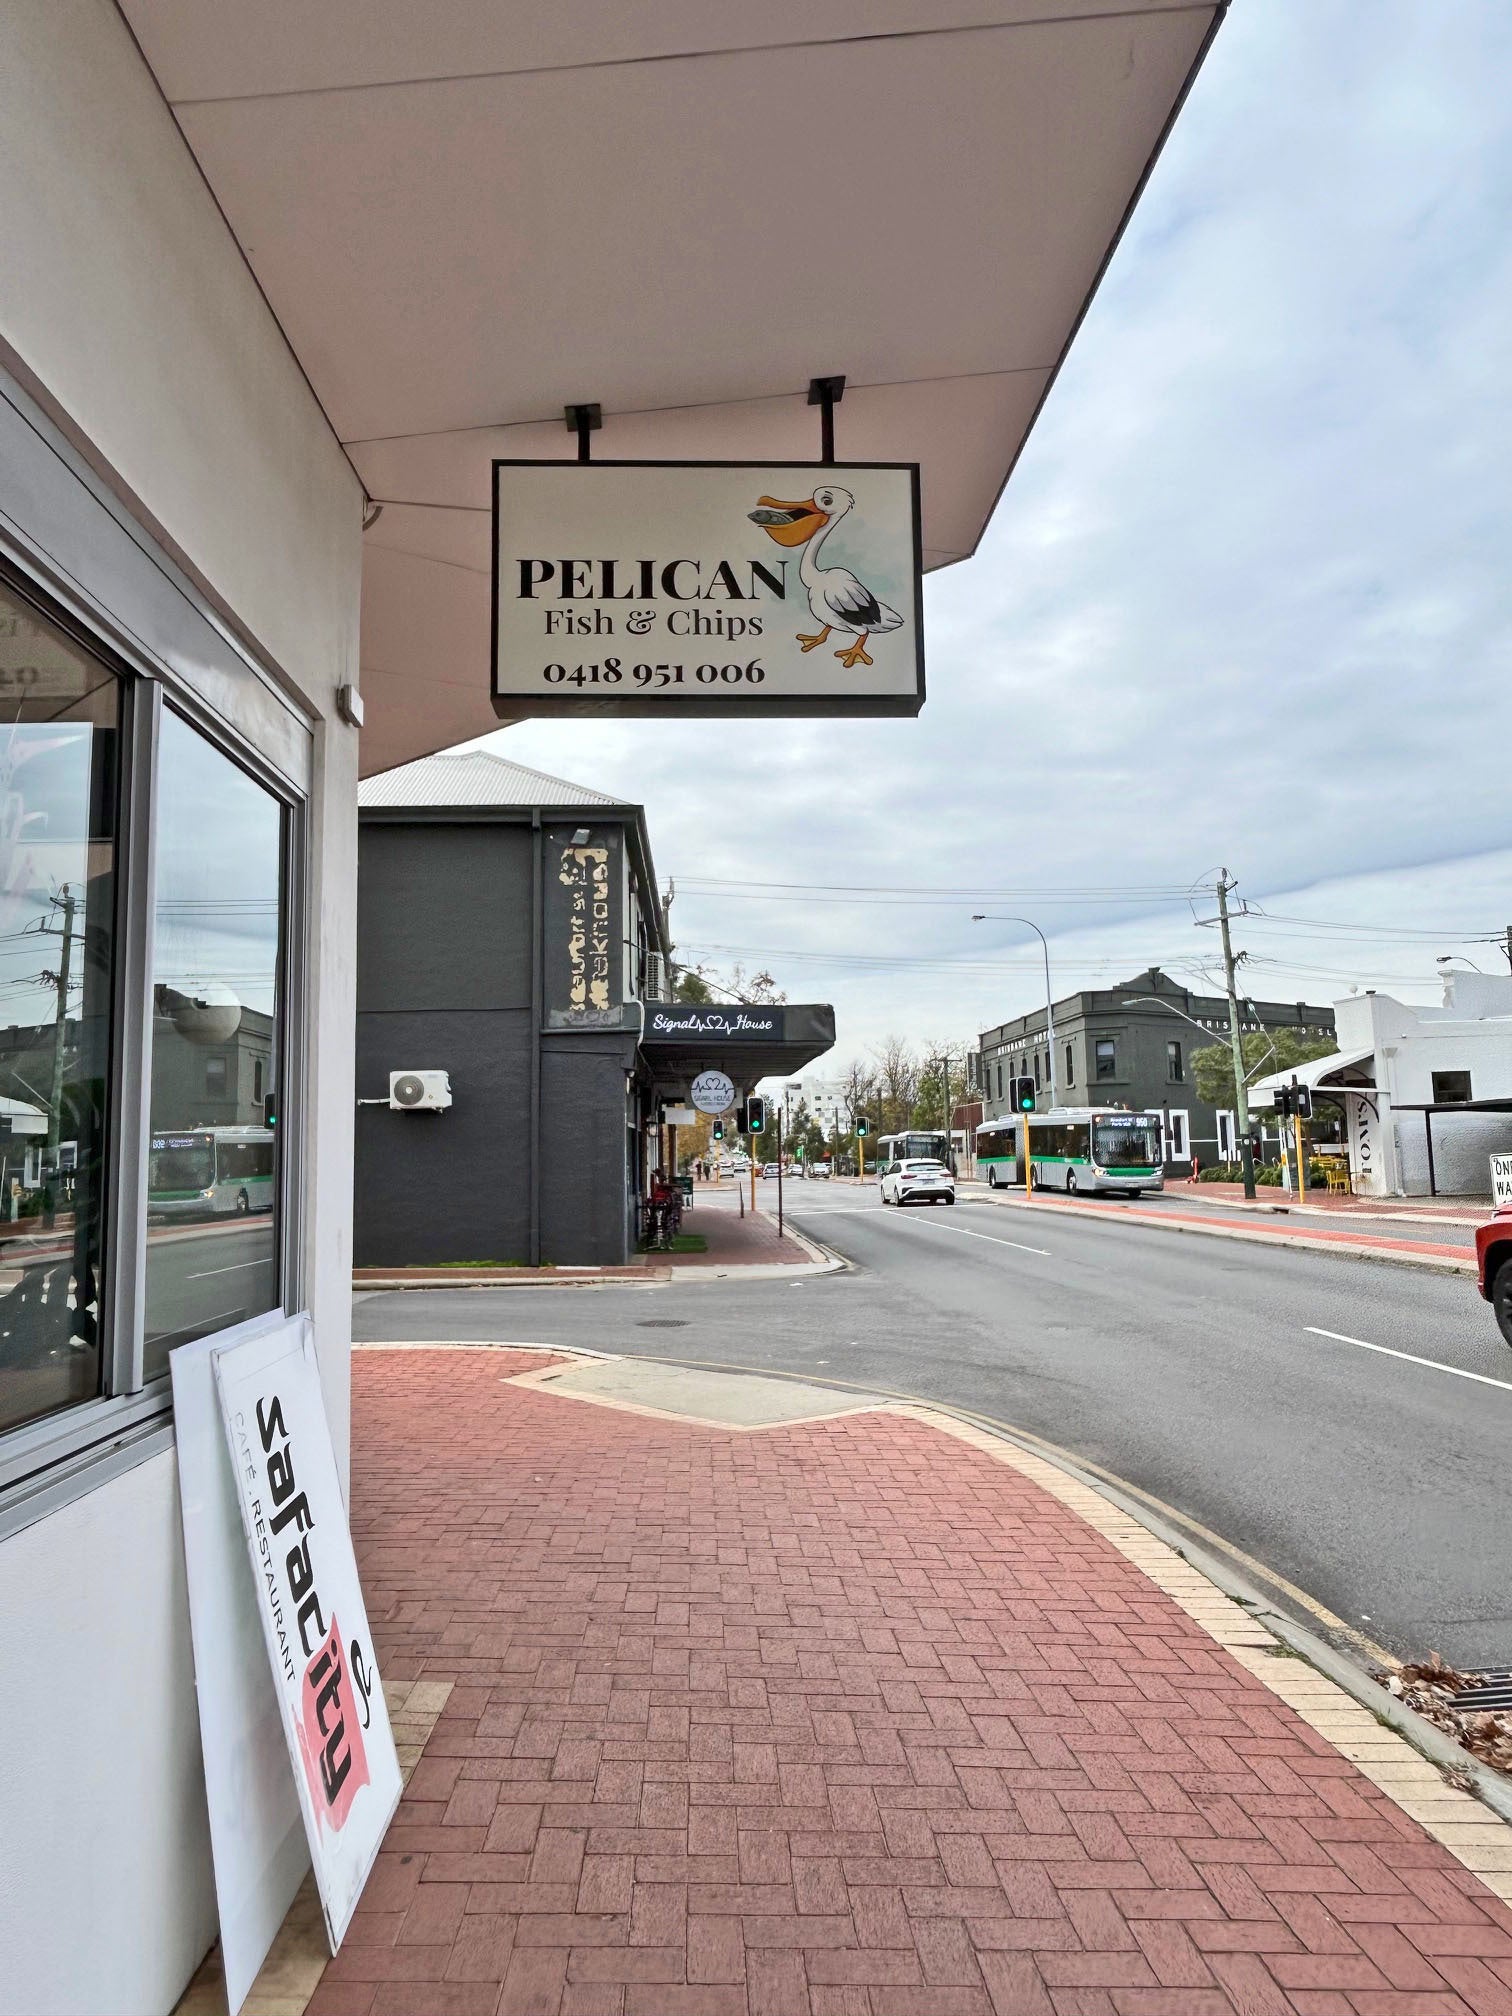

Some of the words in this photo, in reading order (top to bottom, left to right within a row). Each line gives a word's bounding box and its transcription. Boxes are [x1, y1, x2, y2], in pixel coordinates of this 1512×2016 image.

[516, 559, 789, 600] PELICAN
[544, 609, 614, 636] Fish
[626, 610, 656, 636] &
[667, 608, 763, 642] Chips
[543, 657, 623, 688] 0418
[633, 662, 684, 688] 951
[696, 658, 765, 684] 006
[653, 1014, 697, 1032] Signal
[737, 1014, 773, 1030] House
[1196, 1019, 1265, 1031] BRISANE
[1291, 1026, 1332, 1036] OEL
[1496, 1161, 1512, 1175] ON
[1497, 1181, 1512, 1195] WA
[251, 1497, 297, 1683] RESTAURANT
[256, 1394, 352, 1805] safacity
